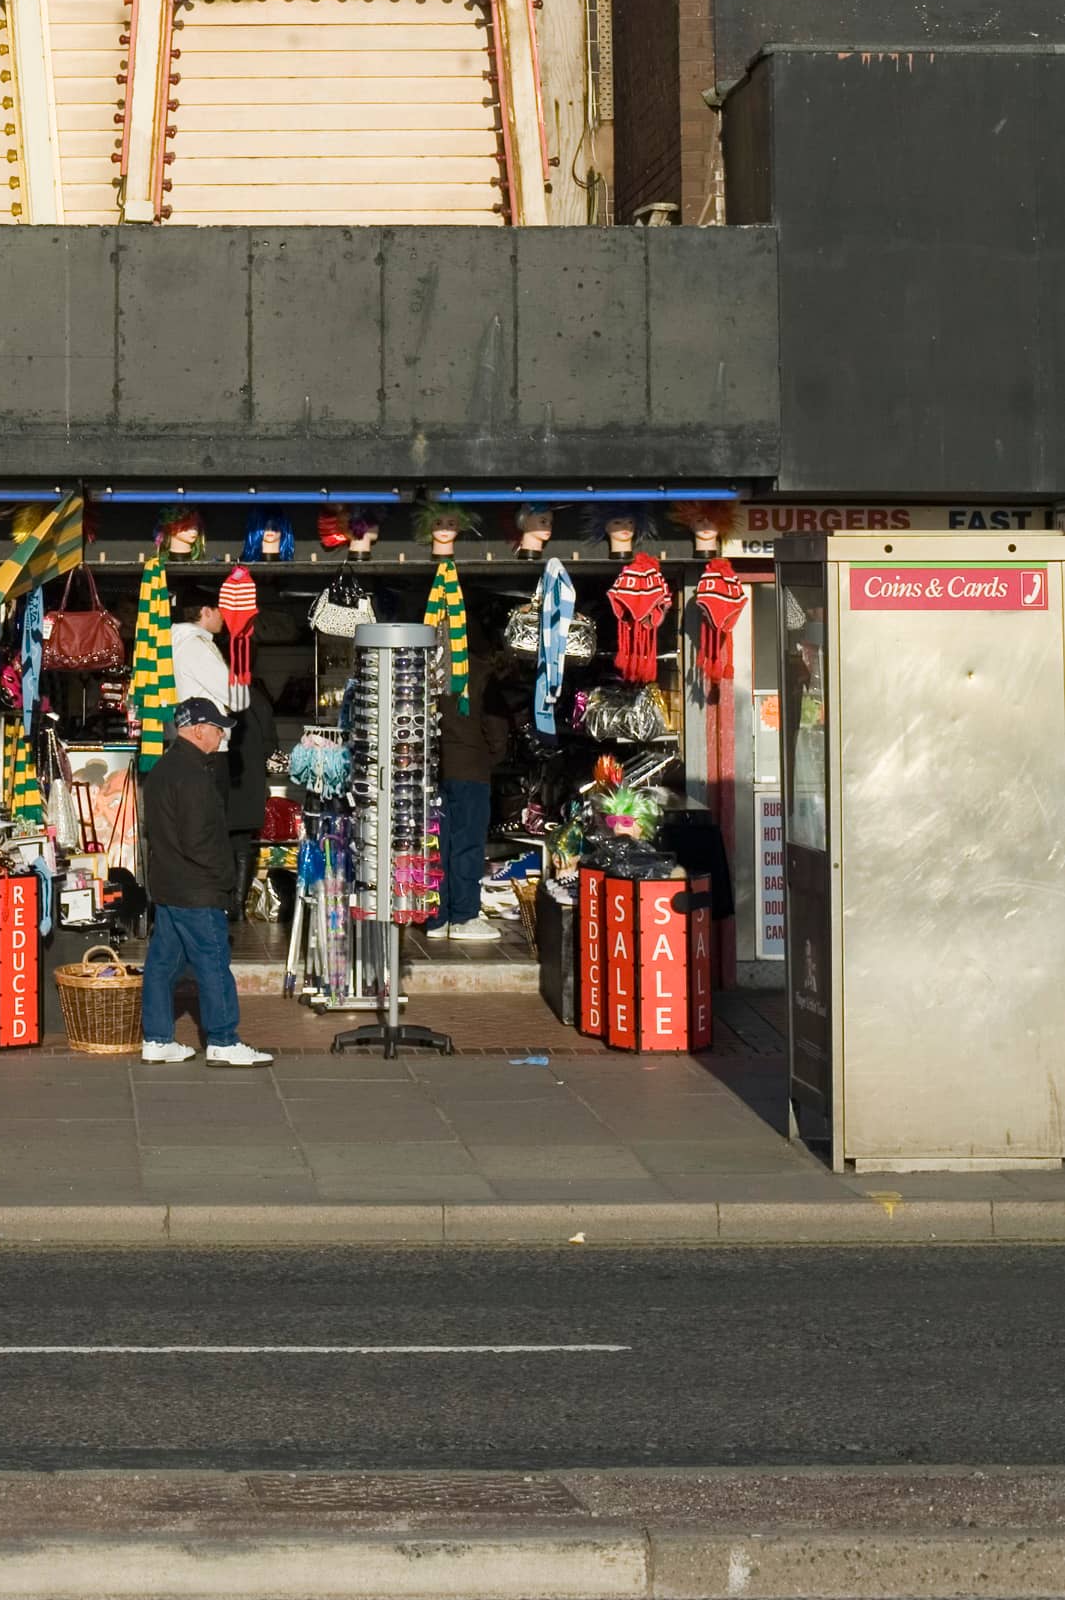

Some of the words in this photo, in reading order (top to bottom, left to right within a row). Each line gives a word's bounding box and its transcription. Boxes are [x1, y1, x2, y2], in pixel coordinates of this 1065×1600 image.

[747, 508, 912, 532] BURGERS
[948, 510, 1032, 531] FAST
[863, 575, 924, 599] Coins
[924, 578, 944, 598] &
[947, 574, 1009, 599] Cards
[11, 885, 27, 1039] REDUCED
[588, 877, 600, 1028] REDUCED
[613, 895, 628, 1032] SALE
[651, 896, 674, 1035] SALE
